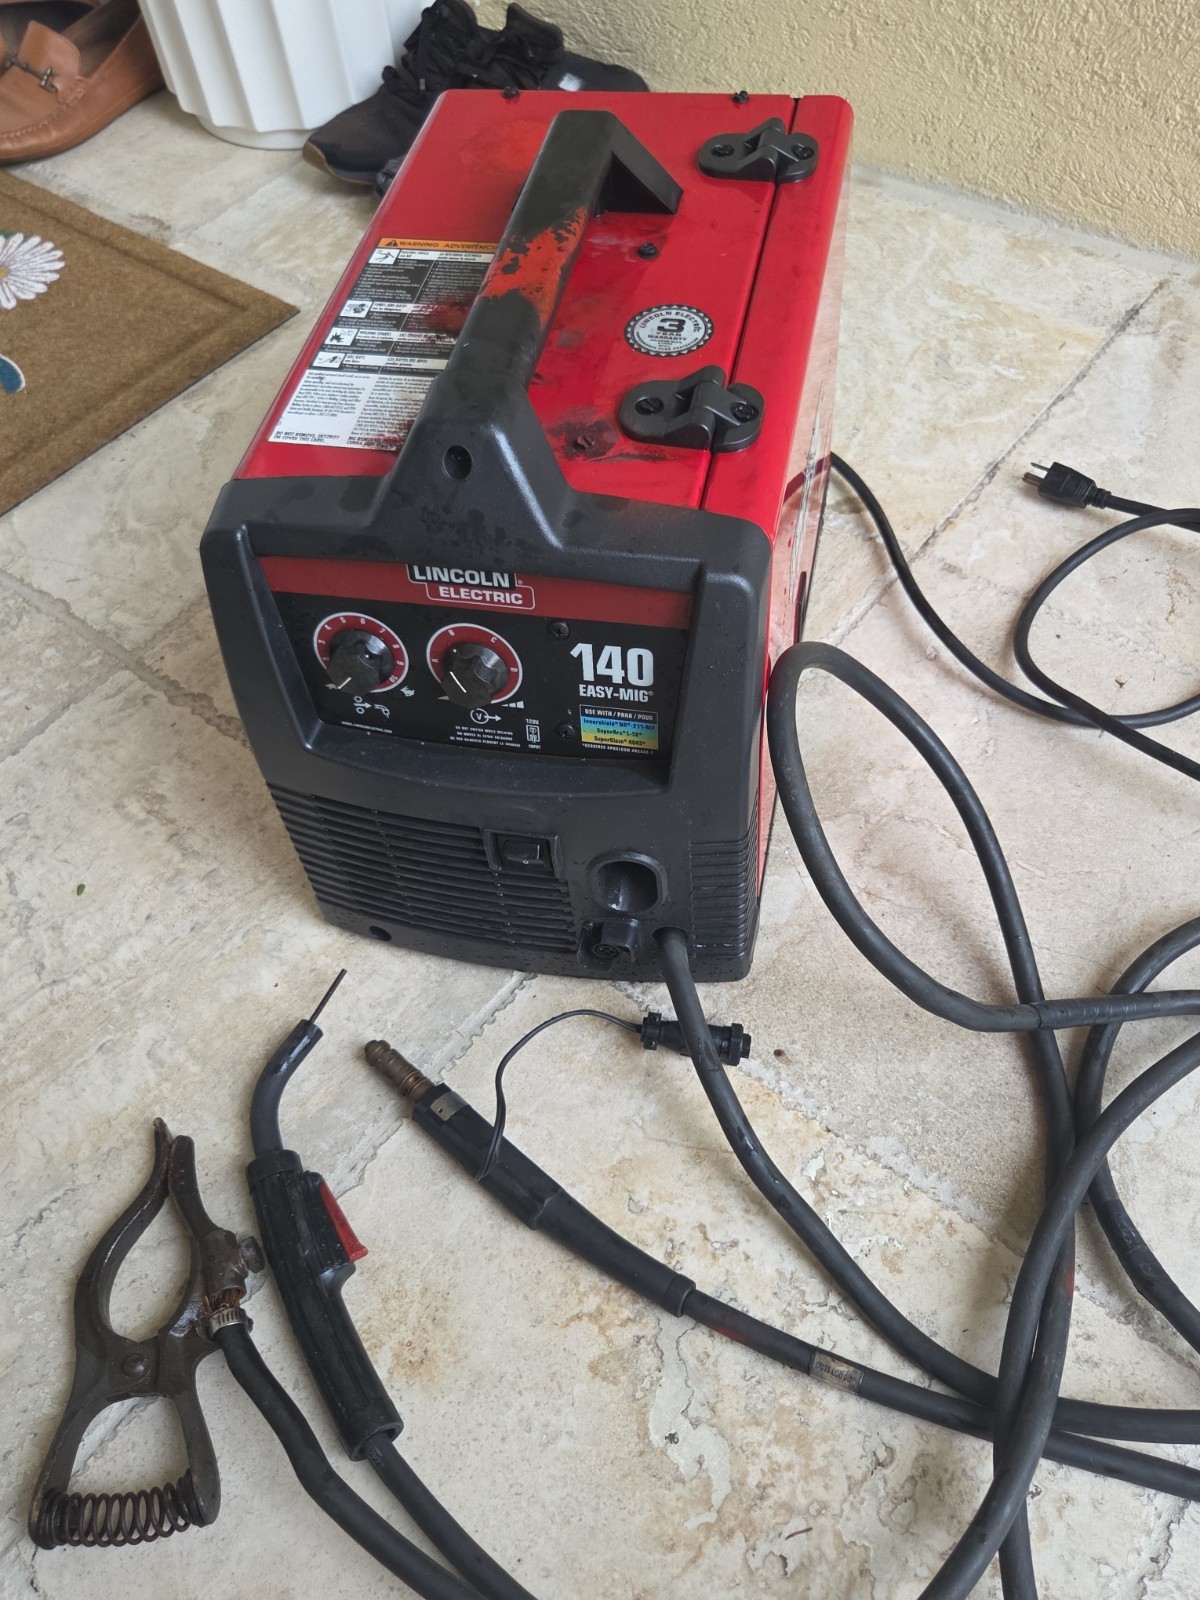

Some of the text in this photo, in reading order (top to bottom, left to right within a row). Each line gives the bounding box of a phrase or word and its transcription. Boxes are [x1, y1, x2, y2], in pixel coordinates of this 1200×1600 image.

[657, 318, 686, 333] 3
[413, 565, 510, 588] LINCOLN
[438, 586, 523, 605] ELECTRIC
[570, 643, 654, 687] 140
